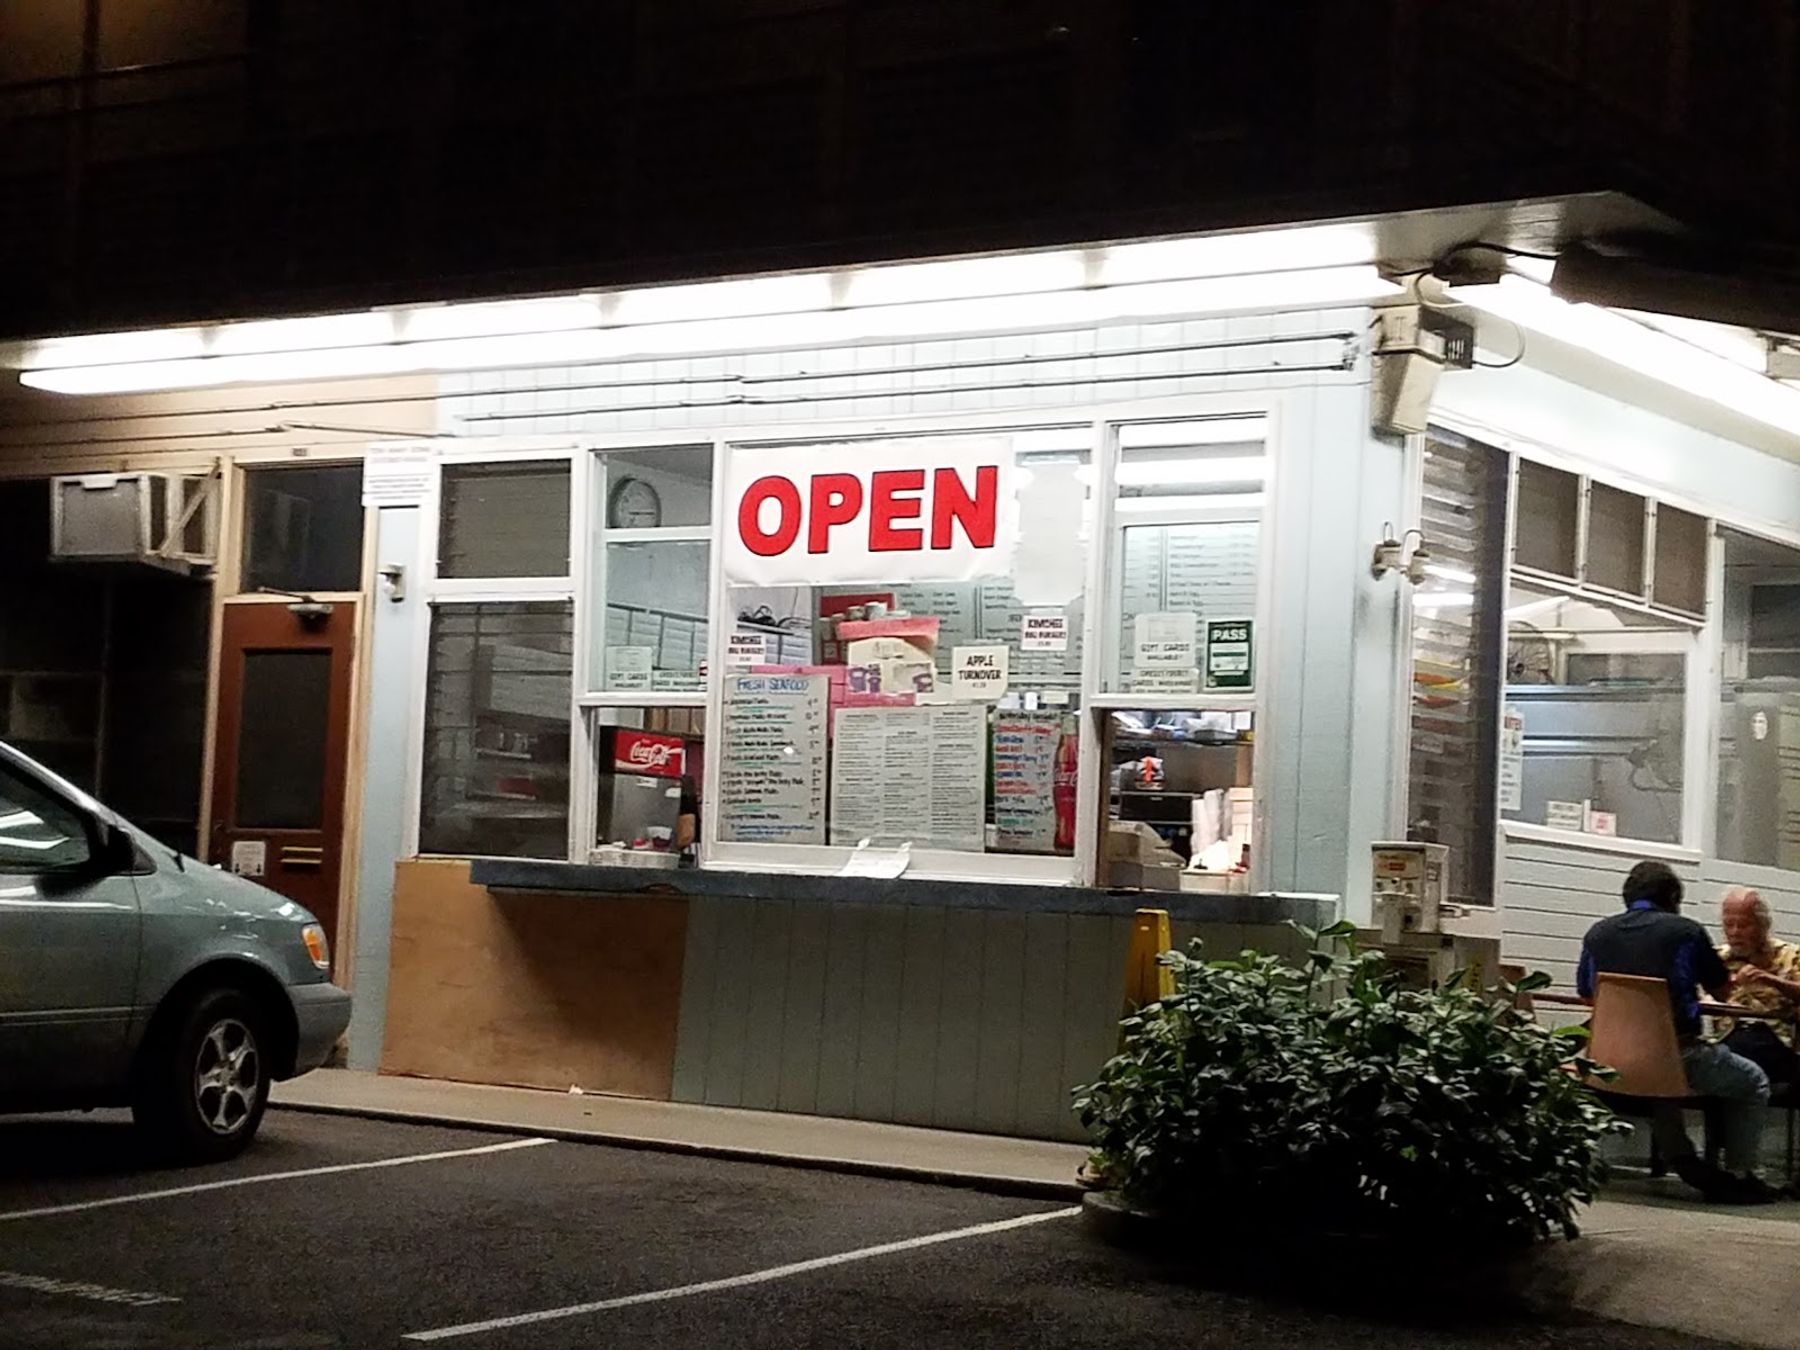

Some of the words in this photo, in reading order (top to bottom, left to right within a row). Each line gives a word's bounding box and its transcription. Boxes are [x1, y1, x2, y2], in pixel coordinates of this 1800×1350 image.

[738, 465, 998, 557] OPEN
[1210, 628, 1248, 641] PASS
[966, 655, 994, 667] APPLE
[958, 669, 1002, 680] TURNOVER
[737, 678, 766, 691] FRESH
[768, 677, 809, 691] SEAFOOD
